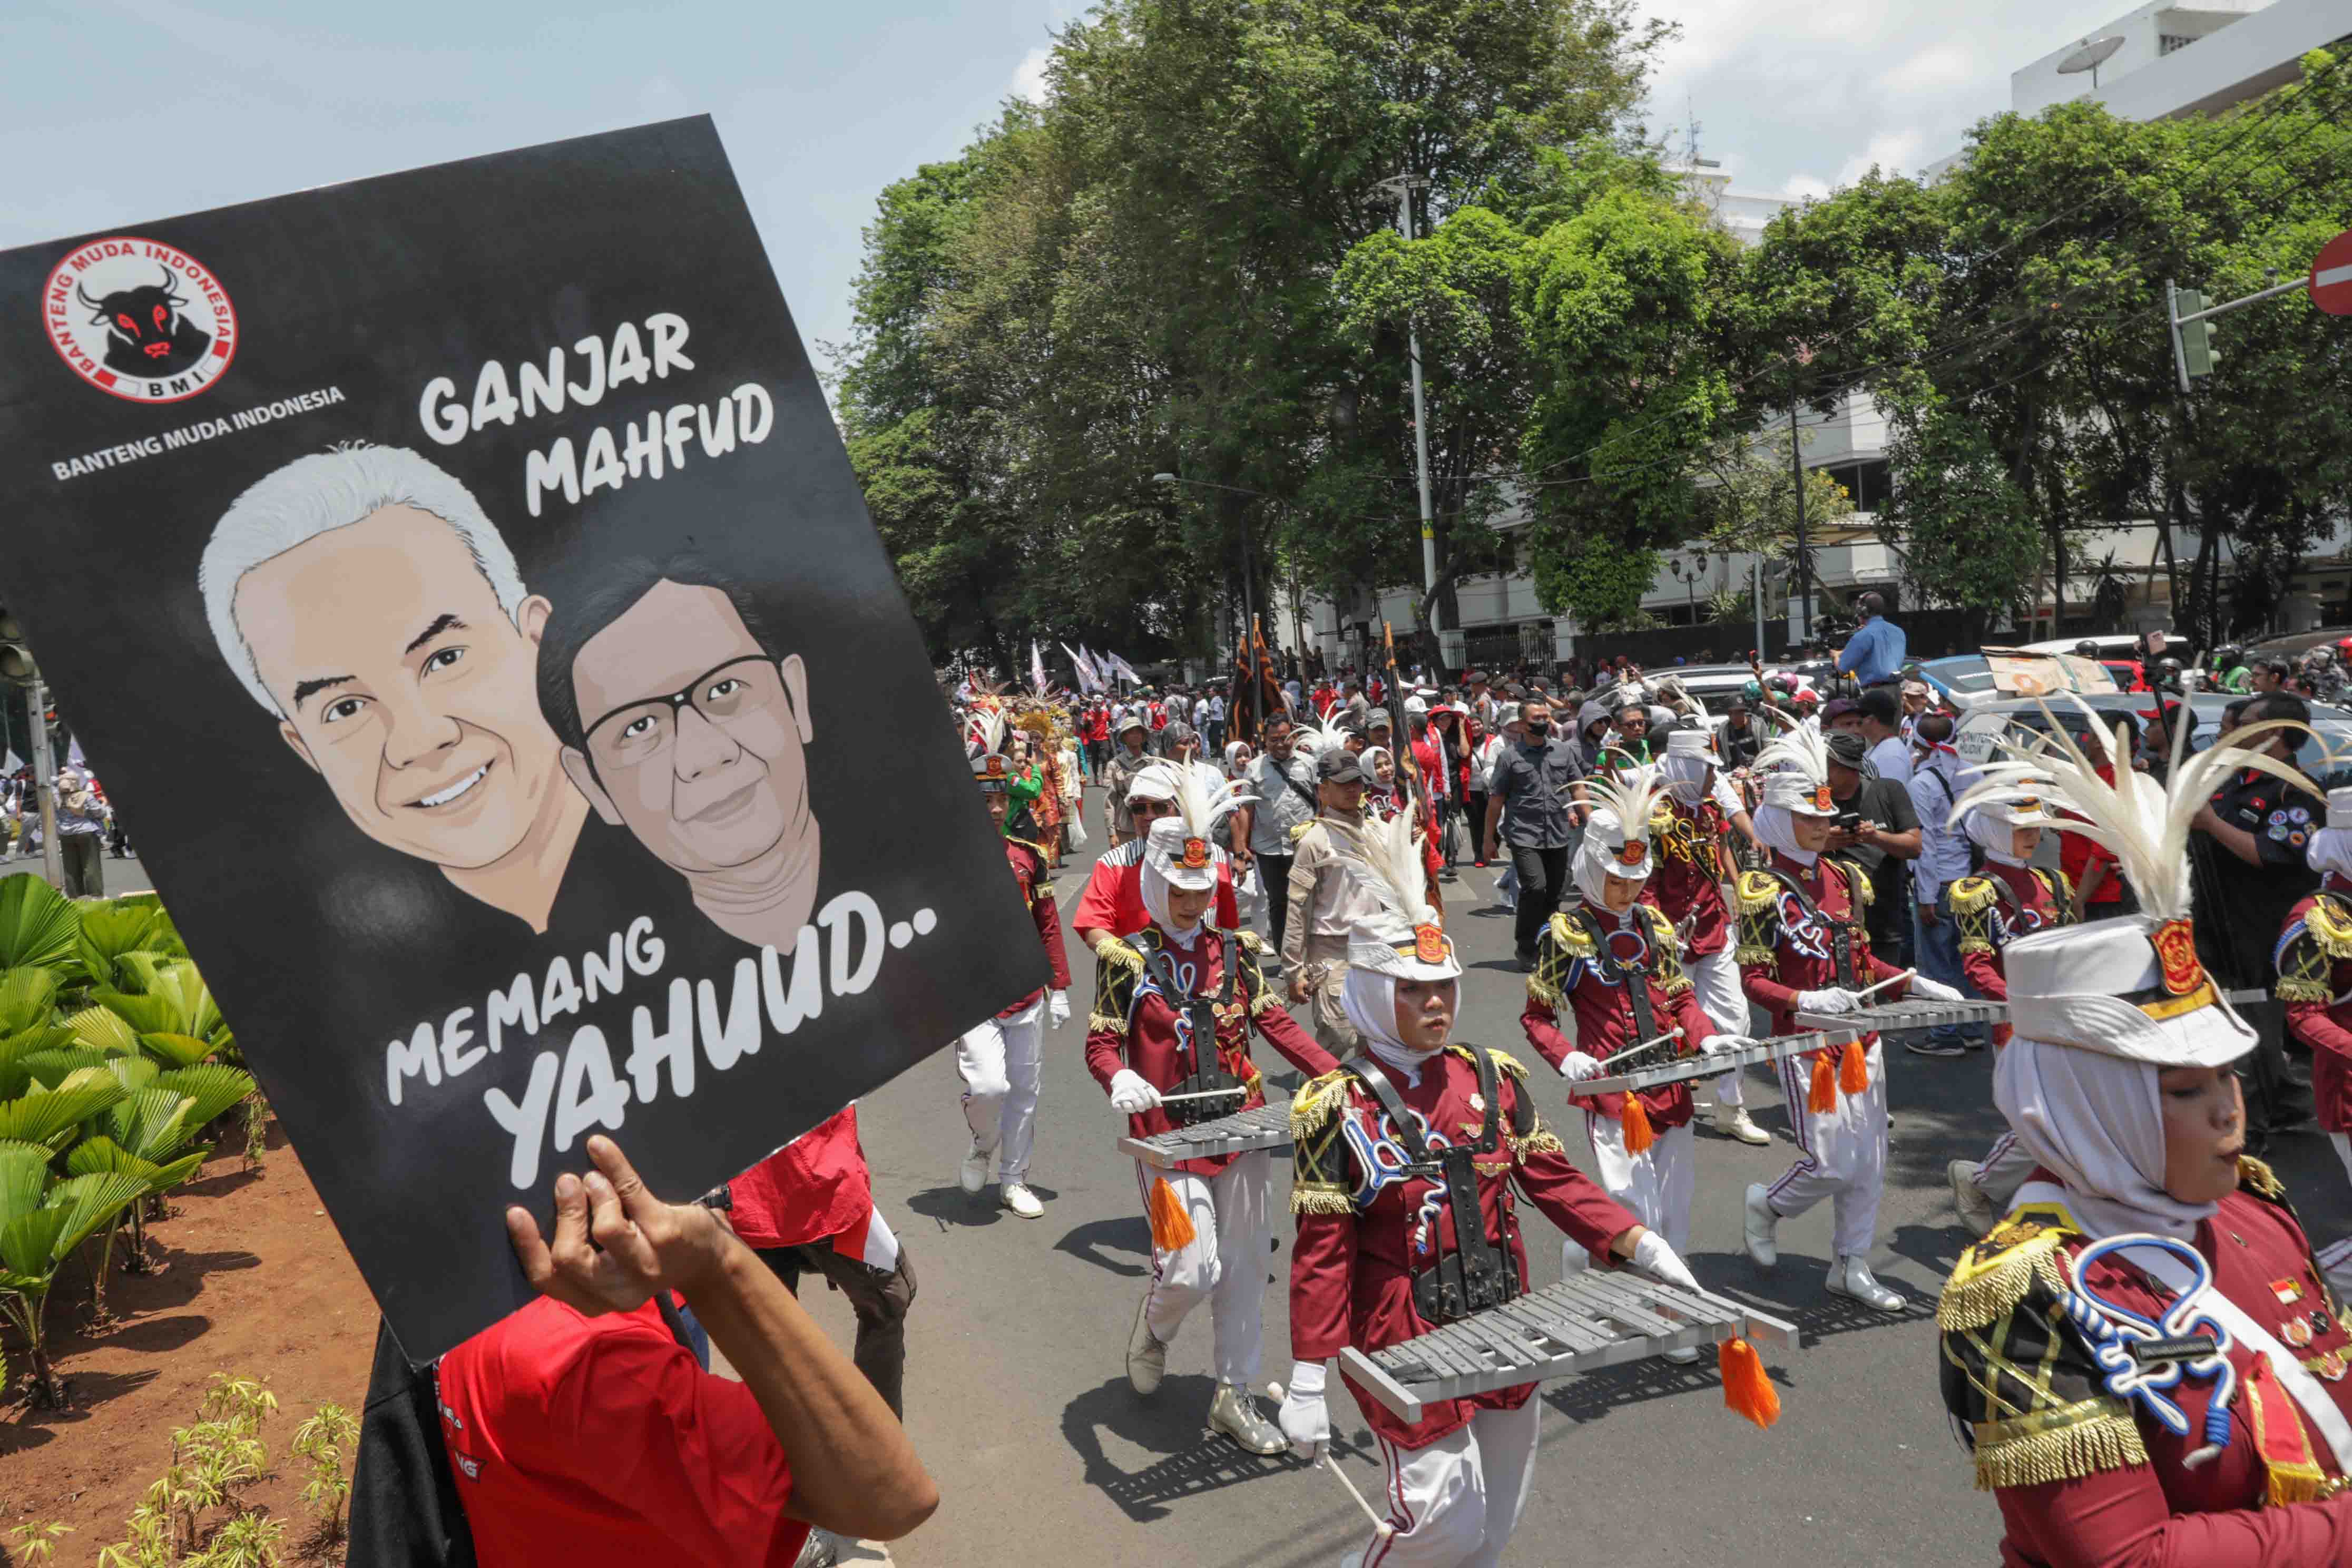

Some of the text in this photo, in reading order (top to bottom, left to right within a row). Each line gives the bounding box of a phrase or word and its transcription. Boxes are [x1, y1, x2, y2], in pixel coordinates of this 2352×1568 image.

[52, 242, 231, 372] BANTENG MUDA INDONESIA
[52, 386, 346, 481] BANTENG MUDA INDONESIA
[419, 312, 694, 445] GANJAR
[526, 383, 773, 517] MAHFUD
[386, 916, 665, 1105] MEMANG
[484, 890, 937, 1190] YAHUUD..
